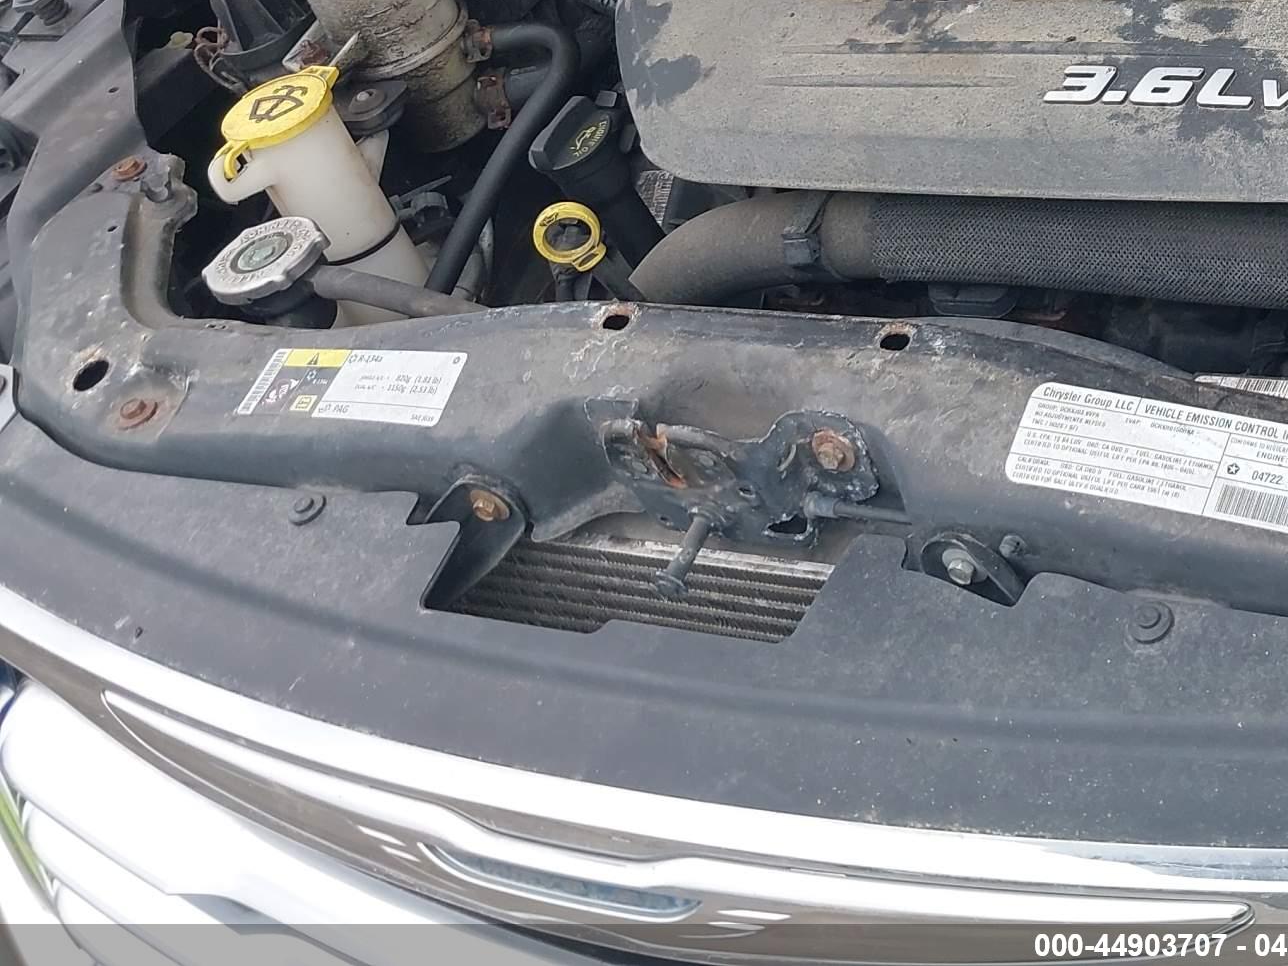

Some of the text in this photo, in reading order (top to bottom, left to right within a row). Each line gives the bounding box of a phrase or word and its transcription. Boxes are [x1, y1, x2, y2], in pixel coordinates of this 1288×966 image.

[1043, 65, 1254, 108] 3.6L
[1043, 387, 1134, 409] Chrysler Group LLC
[333, 405, 350, 413] PAG
[1144, 406, 1183, 419] VEHICLE
[1186, 413, 1231, 428] EMISSION
[1235, 423, 1279, 437] CONTROL
[1256, 450, 1288, 462] ENGINE:
[1252, 471, 1281, 483] 04722
